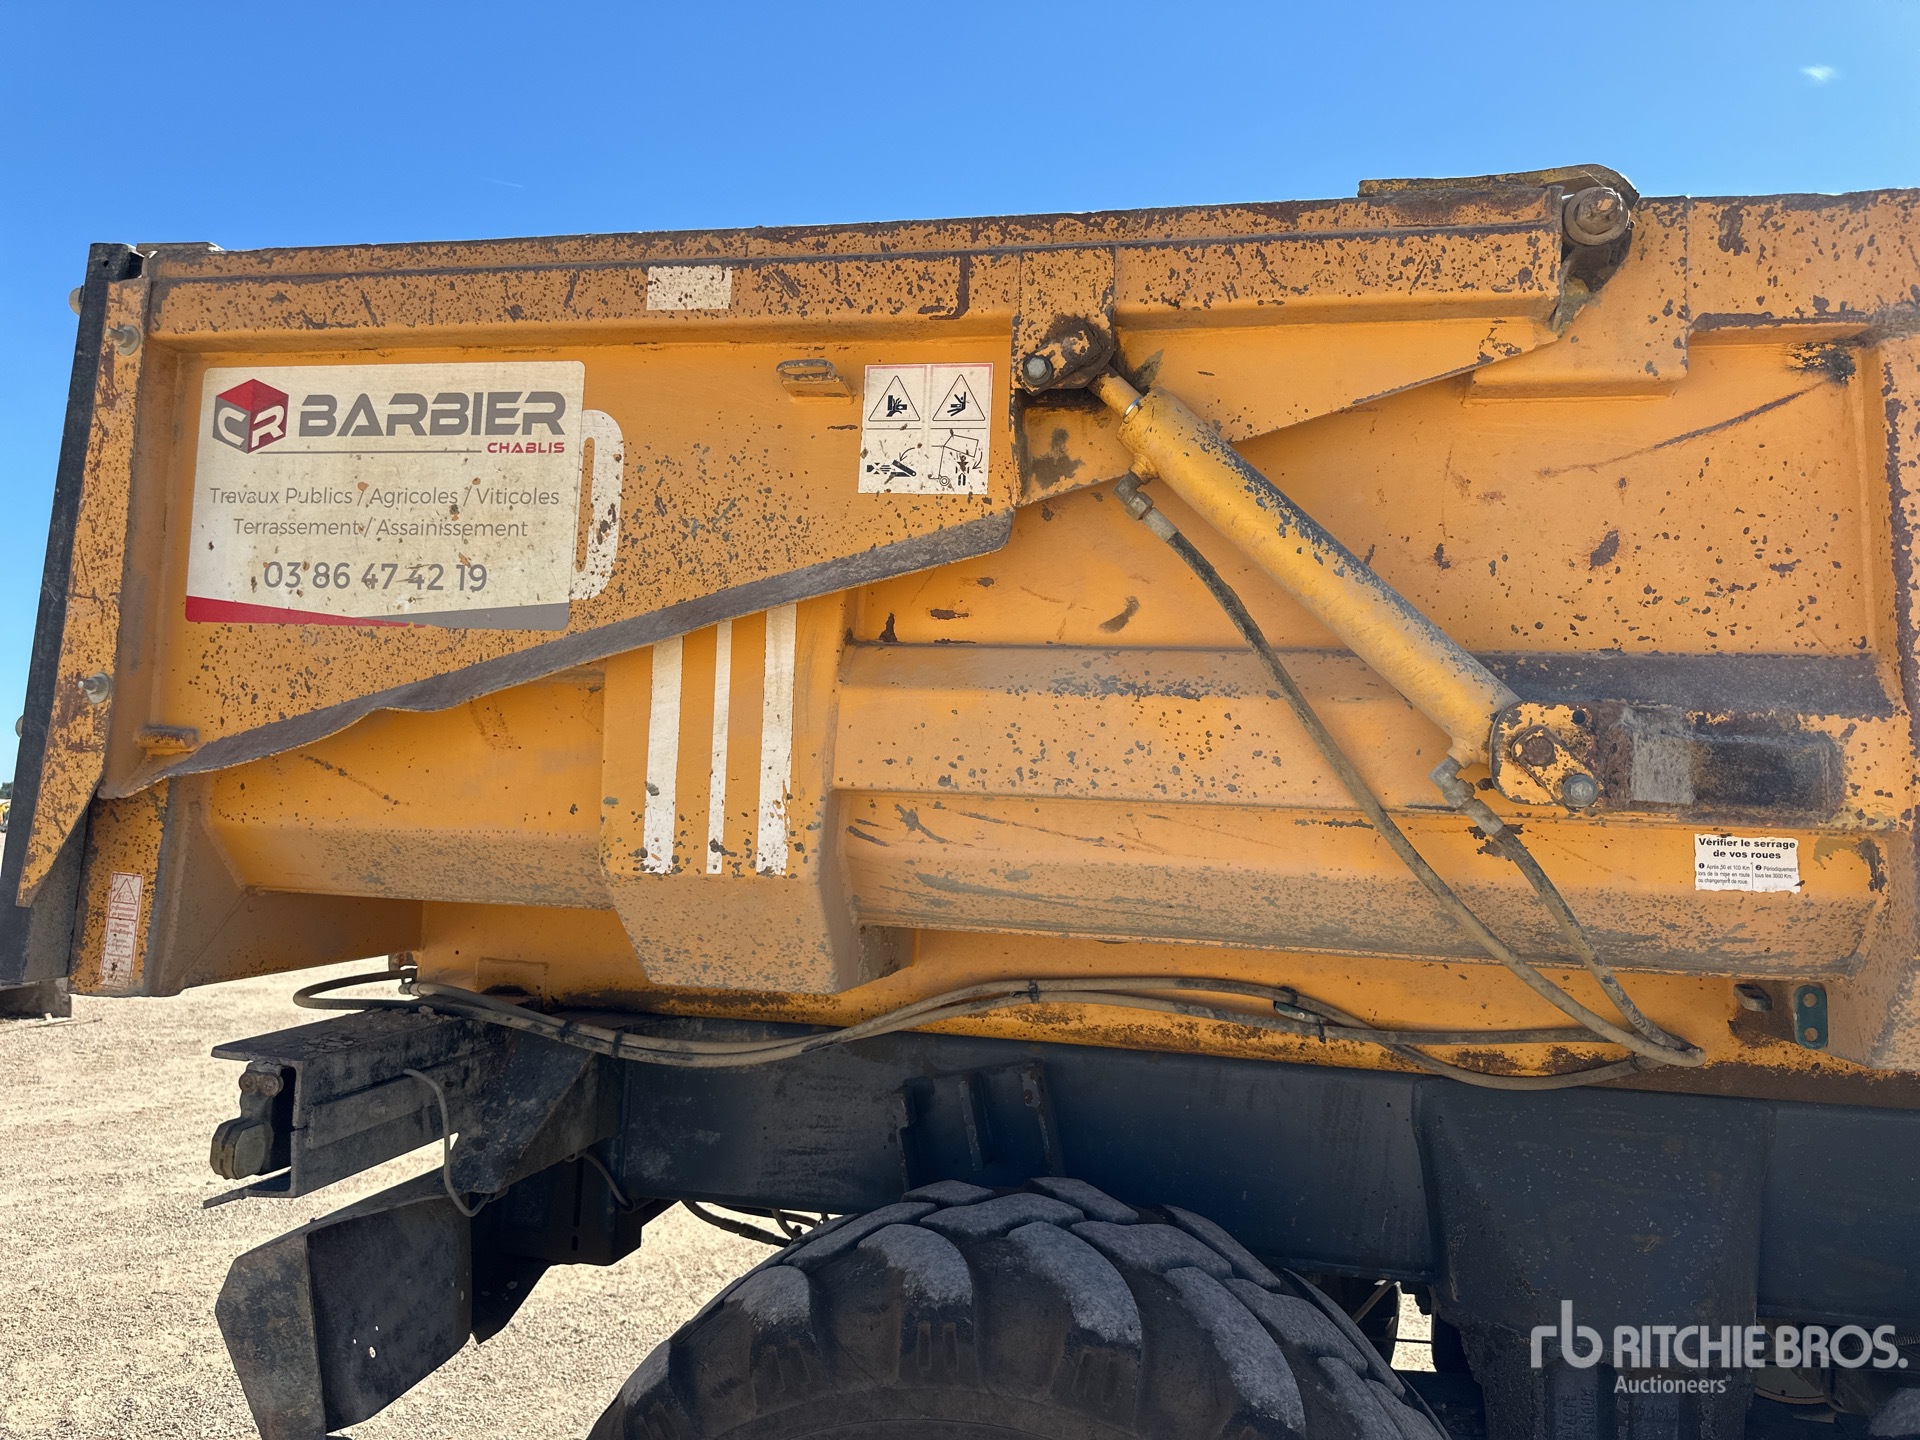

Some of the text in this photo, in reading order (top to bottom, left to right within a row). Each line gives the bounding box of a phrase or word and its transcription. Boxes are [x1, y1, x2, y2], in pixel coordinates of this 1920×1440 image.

[298, 391, 567, 438] BARBIER
[487, 442, 566, 454] CHABLIS
[210, 487, 279, 504] Travaux
[286, 487, 353, 504] Publics
[370, 487, 458, 508] Agricoles
[476, 487, 560, 505] Viticoles
[234, 518, 360, 536] Terrassement
[375, 519, 529, 537] Assainissement
[263, 561, 488, 593] 03 86 47 42 19
[1698, 837, 1796, 850] Vérifier le serrage
[1713, 849, 1782, 860] de vos roues
